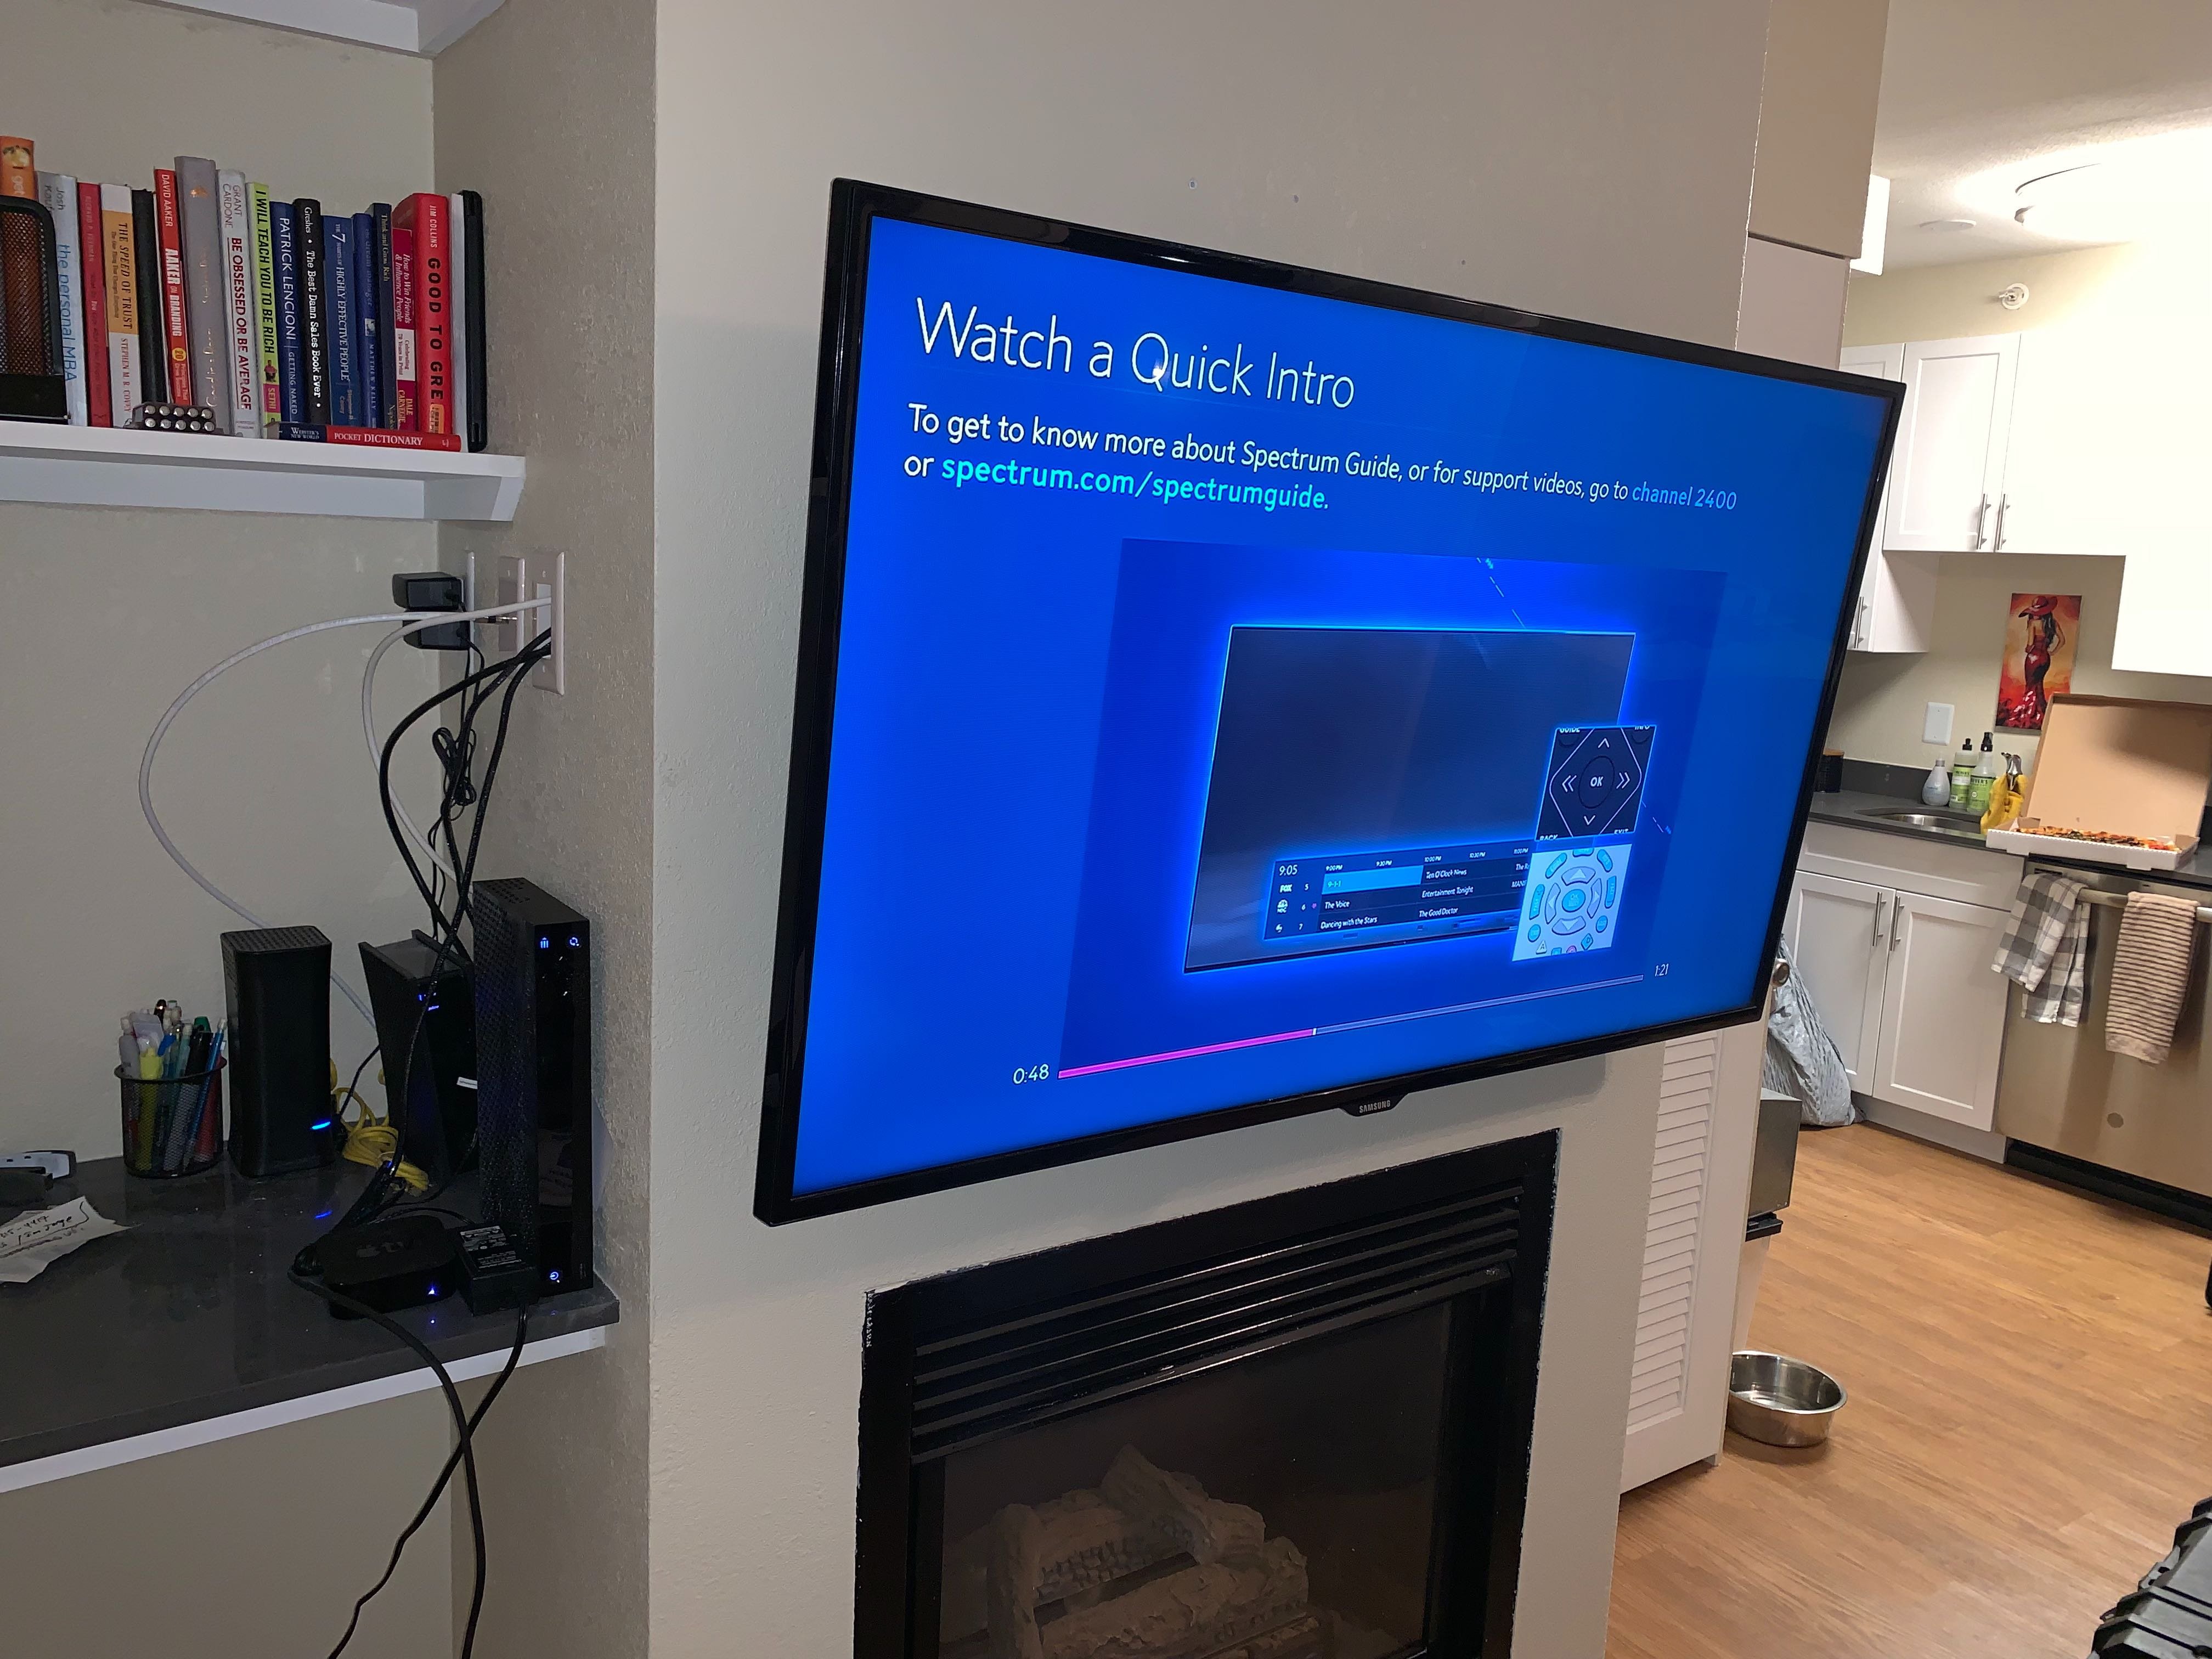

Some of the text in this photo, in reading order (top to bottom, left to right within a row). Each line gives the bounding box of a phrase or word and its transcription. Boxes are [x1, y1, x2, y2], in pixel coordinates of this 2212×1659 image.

[56, 187, 65, 210] Josh
[161, 174, 173, 227] DAVID AAKER
[223, 183, 242, 229] GRANT CARDONE
[256, 199, 268, 224] WILL
[232, 237, 242, 253] BE
[258, 228, 270, 264] TEACH
[332, 233, 346, 243] 7
[430, 219, 438, 248] COLLINS
[119, 222, 133, 329] THE SPEED OF TRUST
[165, 248, 180, 285] AAKER
[260, 267, 271, 289] YOU
[279, 217, 296, 340] PATRICK LENCIONI
[233, 255, 246, 314] OBSESSED
[336, 267, 346, 300] HIGHLY
[428, 257, 442, 313] GOOD
[261, 292, 272, 306] TO
[304, 207, 322, 398] Greshes The Best Damn Sales Book Ever
[396, 296, 404, 322] People
[57, 244, 77, 381] the personal MBA
[170, 295, 182, 336] BRANDING
[262, 309, 273, 324] BE
[337, 300, 348, 347] EFFECTIVE
[236, 317, 247, 335] OR
[430, 324, 443, 350] TO
[238, 337, 248, 353] BE
[263, 326, 274, 353] RICH
[916, 296, 1355, 409] Watch a Quick Intro
[121, 337, 129, 370] STEPHEN
[174, 349, 184, 360] 20
[339, 347, 350, 381] PEOPLE
[239, 355, 252, 410] AVERAGE
[288, 352, 298, 414] GETTING NAKED
[123, 390, 131, 412] COVEY
[268, 387, 276, 409] SETHI
[334, 432, 423, 445] POCKET DICTIONARY
[909, 403, 1738, 510] To get to know more about Spectrum Guide, or for support videos, go to channel 2400
[903, 455, 1330, 512] or spectrum.com/spectrumguide.
[1590, 776, 1604, 787] OK
[1426, 871, 1435, 879] Ten
[1435, 869, 1453, 878] O'Clock
[1279, 884, 1293, 893] FOX
[1421, 885, 1474, 898] Entertainment Tonight
[1335, 900, 1350, 909] Voice
[1428, 908, 1442, 917] Good
[1442, 907, 1458, 915] Doctor
[1320, 921, 1342, 929] Dancing
[1342, 918, 1355, 927] with
[1364, 916, 1378, 924] Stars
[1655, 963, 1669, 977] 1:21
[1013, 1063, 1049, 1084] 0:48
[1359, 1099, 1391, 1114] SAMSUNG
